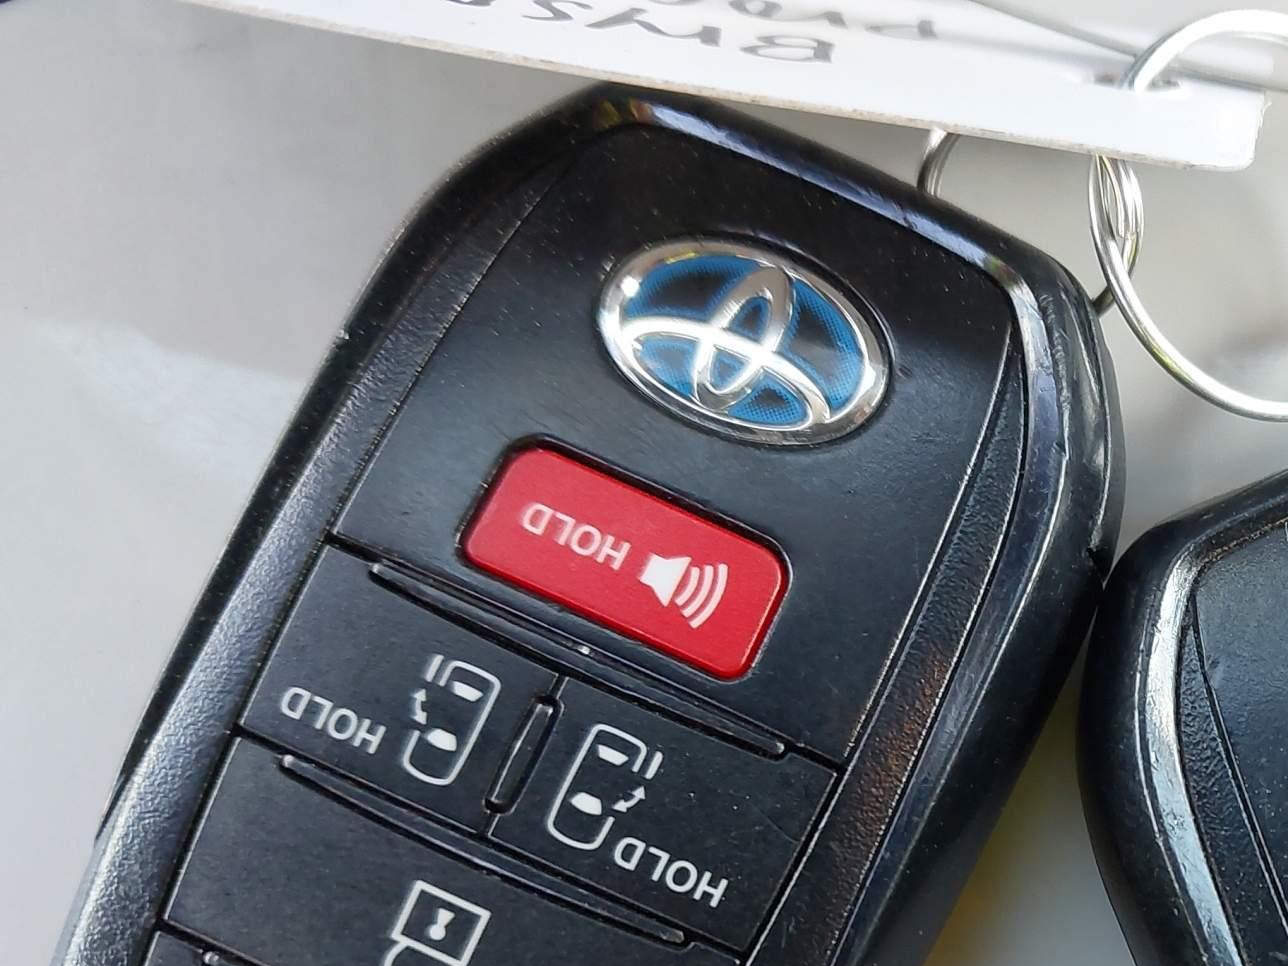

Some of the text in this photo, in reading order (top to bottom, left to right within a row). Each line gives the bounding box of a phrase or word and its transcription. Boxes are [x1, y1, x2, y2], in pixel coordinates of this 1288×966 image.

[520, 502, 631, 570] HOLD
[279, 686, 386, 755] HOLD
[613, 835, 729, 908] HOLD
